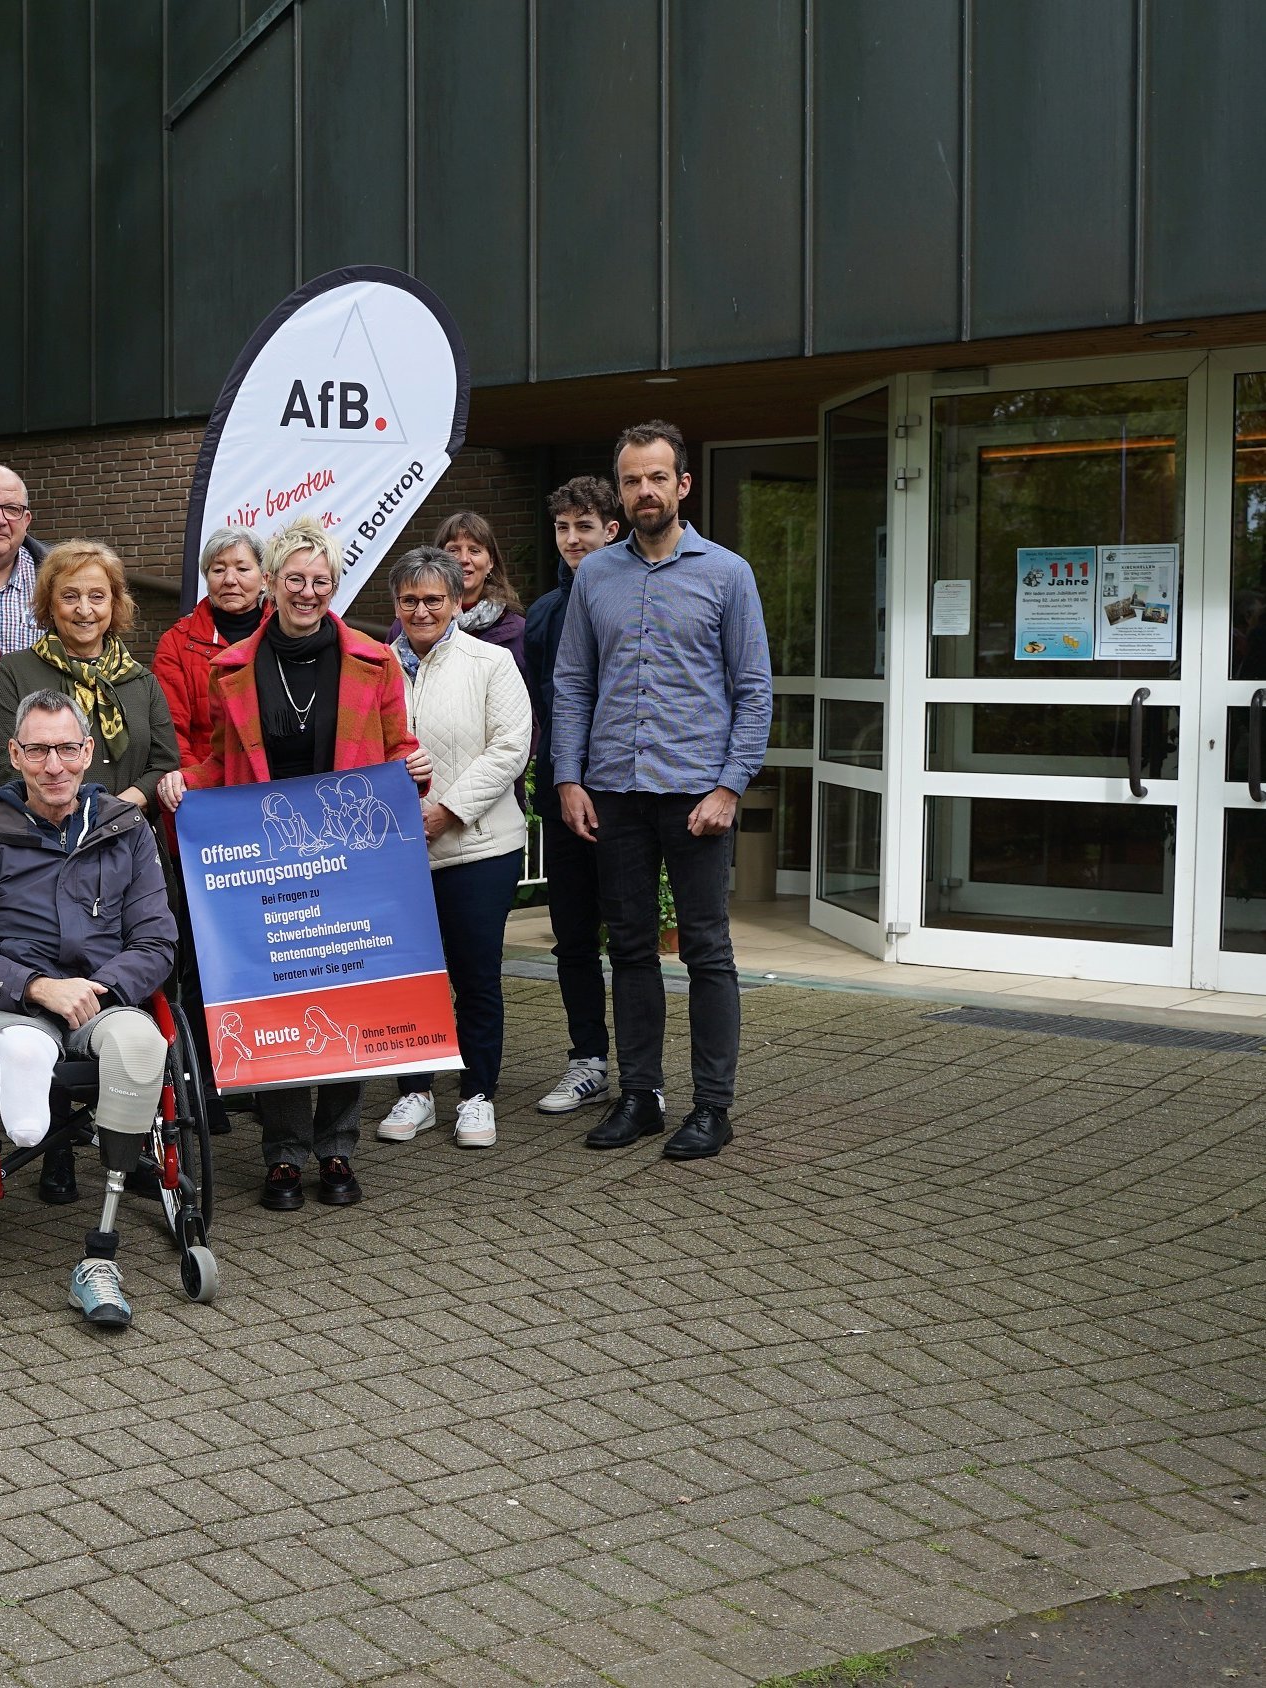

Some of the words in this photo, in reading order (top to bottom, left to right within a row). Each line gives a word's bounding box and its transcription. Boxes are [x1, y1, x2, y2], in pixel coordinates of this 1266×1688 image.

[280, 379, 387, 431] AfB.
[266, 469, 336, 517] beraten
[357, 460, 425, 541] Bottrop
[1048, 578, 1089, 586] Jahre
[201, 842, 261, 865] Offenes
[205, 854, 348, 891] Beratungsangebot
[261, 895, 276, 905] Bei
[277, 890, 308, 903] Fragen
[310, 889, 320, 898] zu
[264, 904, 321, 925] Bürgergeld
[267, 919, 371, 944] Schwerbehinderung
[270, 935, 393, 963] Rentenangelegenheiten
[273, 969, 308, 982] beraten
[309, 965, 324, 976] wir
[325, 963, 340, 974] Sie
[342, 959, 365, 974] gern!
[254, 1024, 300, 1047] Heute
[362, 1029, 385, 1039] Ohne
[386, 1022, 417, 1036] Termin
[364, 1041, 389, 1054] 10.00
[390, 1039, 405, 1050] bis
[405, 1035, 430, 1048] 12.00
[431, 1032, 447, 1044] Uhr
